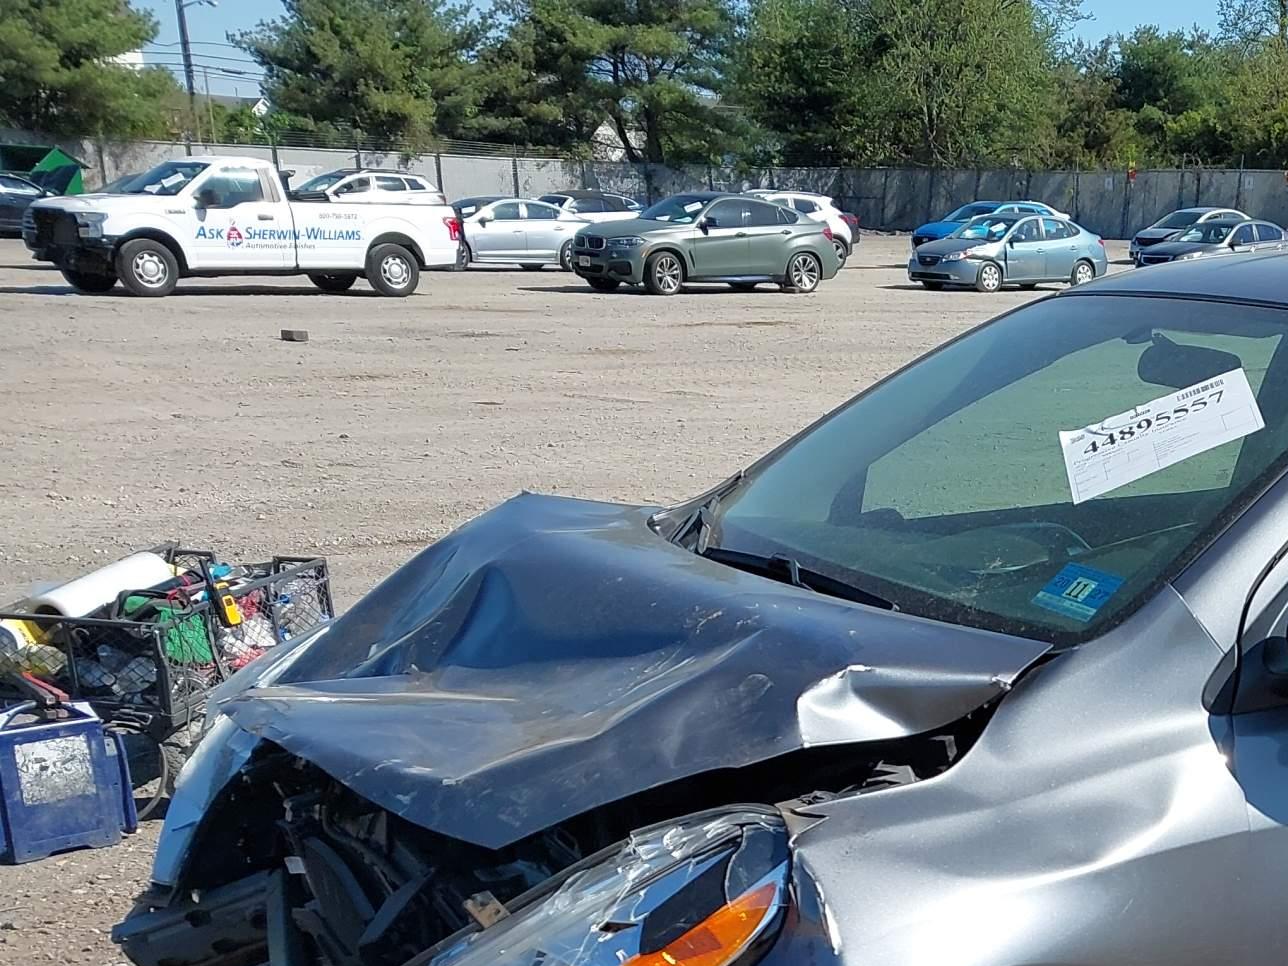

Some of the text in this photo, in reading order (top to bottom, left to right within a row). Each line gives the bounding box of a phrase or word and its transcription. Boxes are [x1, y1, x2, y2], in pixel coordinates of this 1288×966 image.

[195, 225, 224, 240] ASK
[244, 226, 362, 241] SHERWIN-WILLIAMS
[1083, 390, 1224, 455] 44895557
[1065, 580, 1089, 599] 11
